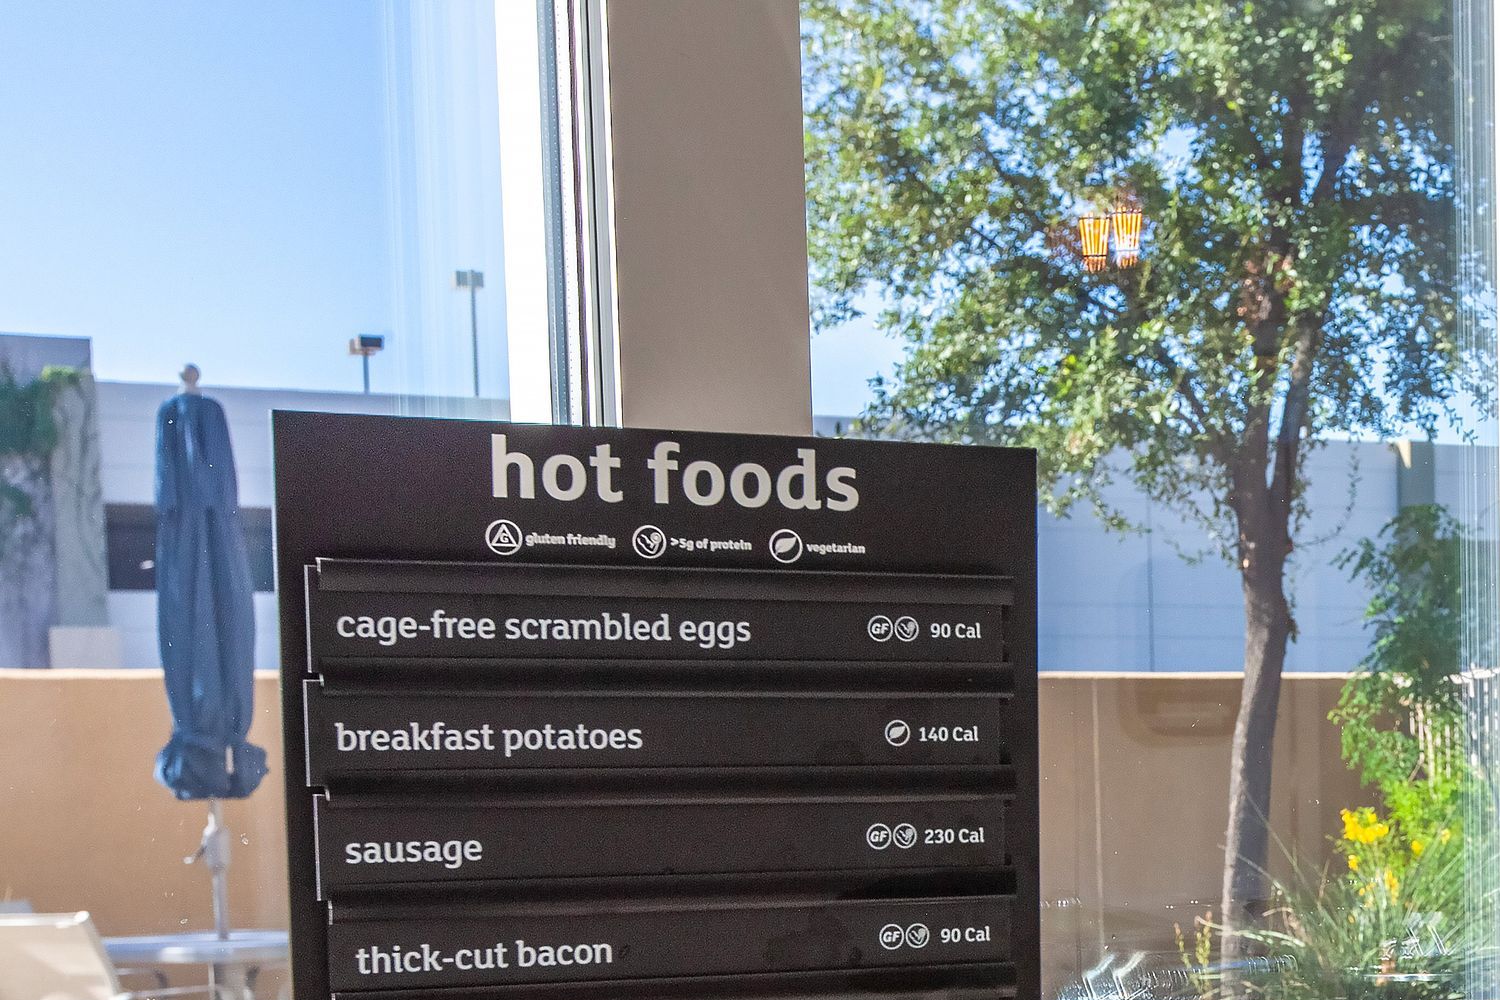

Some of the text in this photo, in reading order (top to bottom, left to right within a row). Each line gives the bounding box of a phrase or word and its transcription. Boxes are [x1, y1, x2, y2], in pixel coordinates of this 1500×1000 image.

[491, 434, 860, 512] hot foods
[525, 532, 566, 546] gluten
[566, 533, 616, 549] friendly
[670, 537, 753, 552] >5g of protein
[806, 543, 866, 555] vegetarian
[336, 608, 752, 650] cage-free scrambled eggs
[871, 622, 982, 639] GF 90 Cal
[335, 722, 644, 758] breakfast potatoes
[919, 725, 979, 742] 140 Cal
[870, 827, 985, 844] GF 230 Cal
[345, 839, 483, 869] sausage
[882, 925, 991, 944] GF 90 Cal
[354, 939, 613, 975] thick-cut bacon
